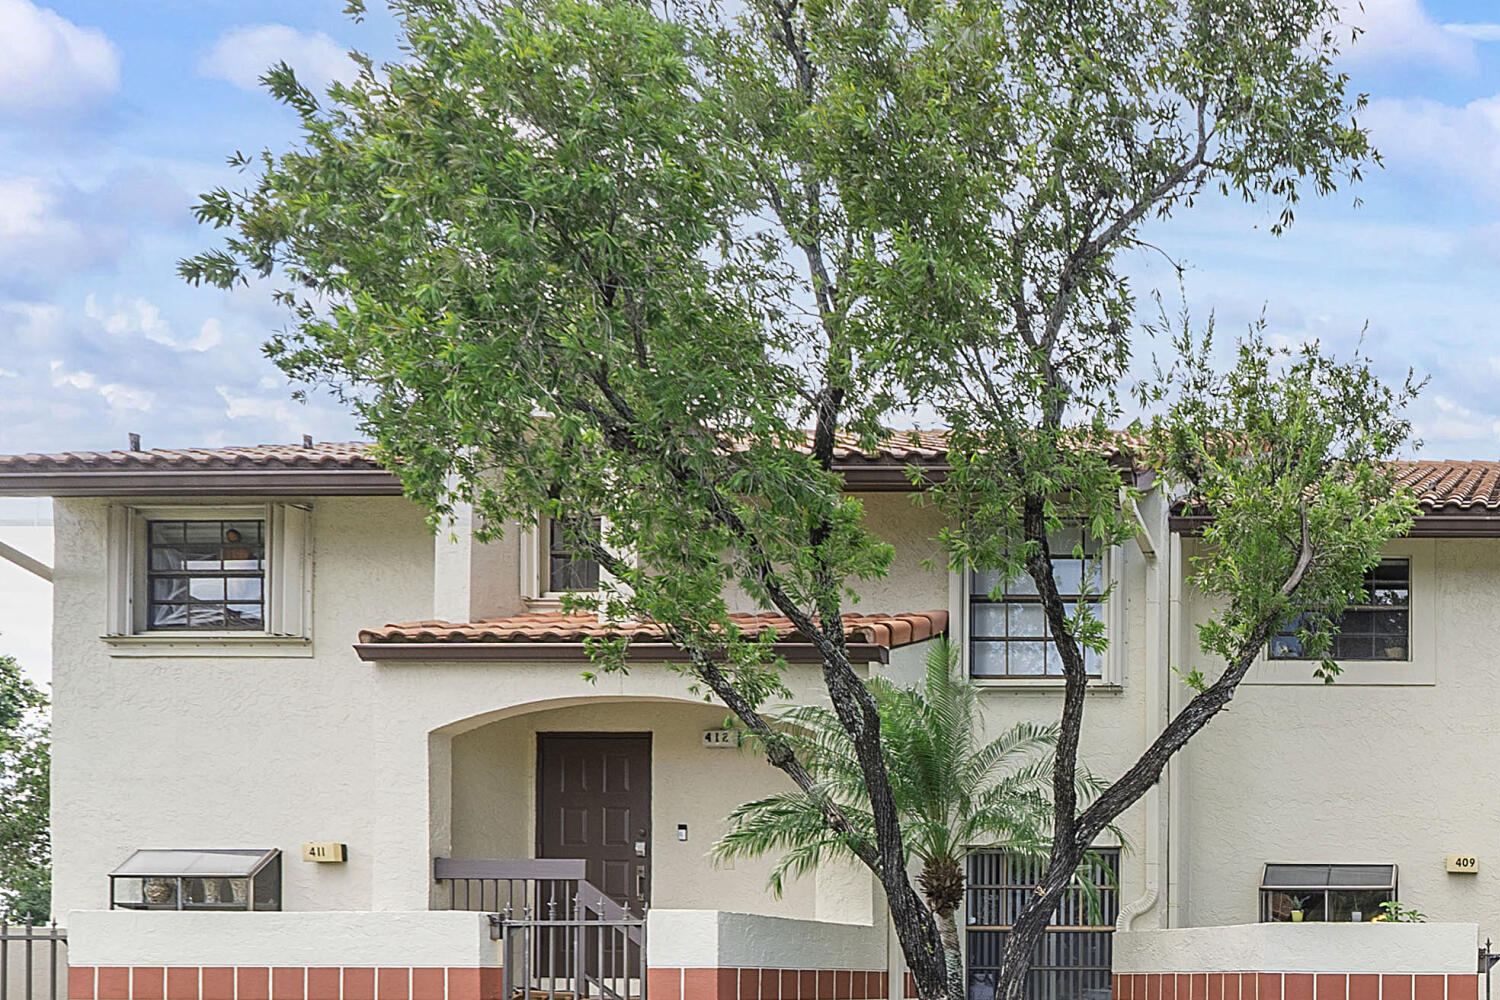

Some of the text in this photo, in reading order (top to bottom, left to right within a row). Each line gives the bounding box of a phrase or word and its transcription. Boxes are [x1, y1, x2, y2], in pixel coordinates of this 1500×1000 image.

[705, 732, 729, 742] 412
[309, 847, 325, 857] 411
[1456, 858, 1475, 867] 409
